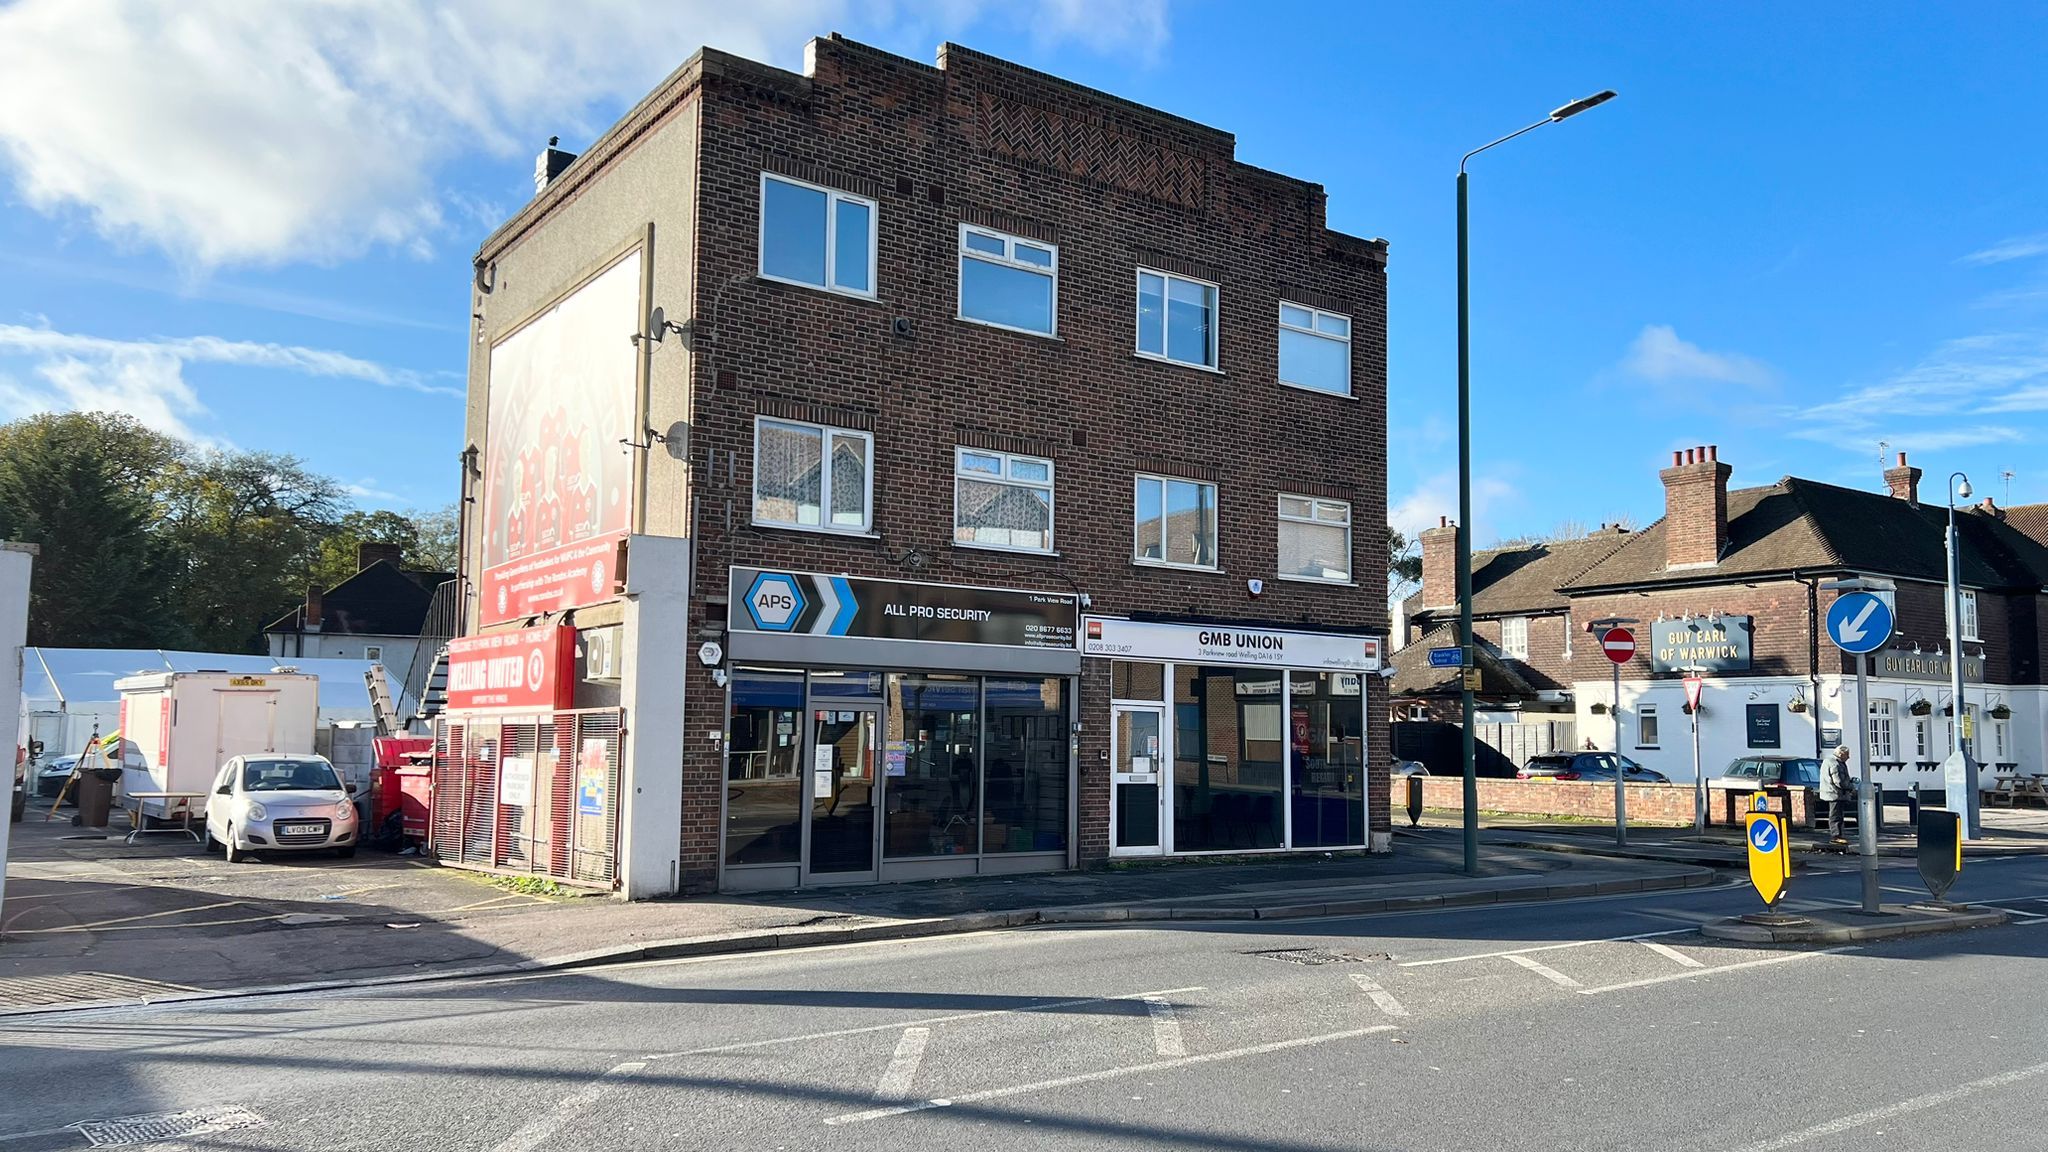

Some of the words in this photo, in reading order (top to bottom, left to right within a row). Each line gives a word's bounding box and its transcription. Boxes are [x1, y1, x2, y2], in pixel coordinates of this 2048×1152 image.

[758, 593, 792, 610] APS
[884, 603, 906, 617] ALL
[909, 605, 934, 619] PRO
[936, 607, 991, 622] SECURITY
[1025, 624, 1039, 632] 020
[1039, 625, 1055, 633] 8677
[1056, 626, 1072, 635] 6633
[1668, 631, 1692, 645] GUY
[1696, 629, 1727, 644] EARL
[1088, 643, 1103, 652] 0208
[1104, 644, 1117, 652] 303
[1117, 645, 1132, 653] 3407
[1199, 631, 1231, 647] GMB
[1236, 633, 1283, 651] UNION
[1225, 650, 1238, 658] road
[1239, 651, 1258, 660] Welling
[1258, 652, 1273, 660] DA16
[1660, 648, 1675, 662] OF
[1680, 645, 1738, 661] WARWICK
[450, 659, 487, 692] WELLING
[488, 655, 524, 689] UNITED
[1886, 656, 1903, 672] GUY
[1905, 658, 1926, 674] EARL
[1928, 660, 1939, 675] OF
[1940, 661, 1978, 677] WAICK
[287, 826, 306, 834] LV09
